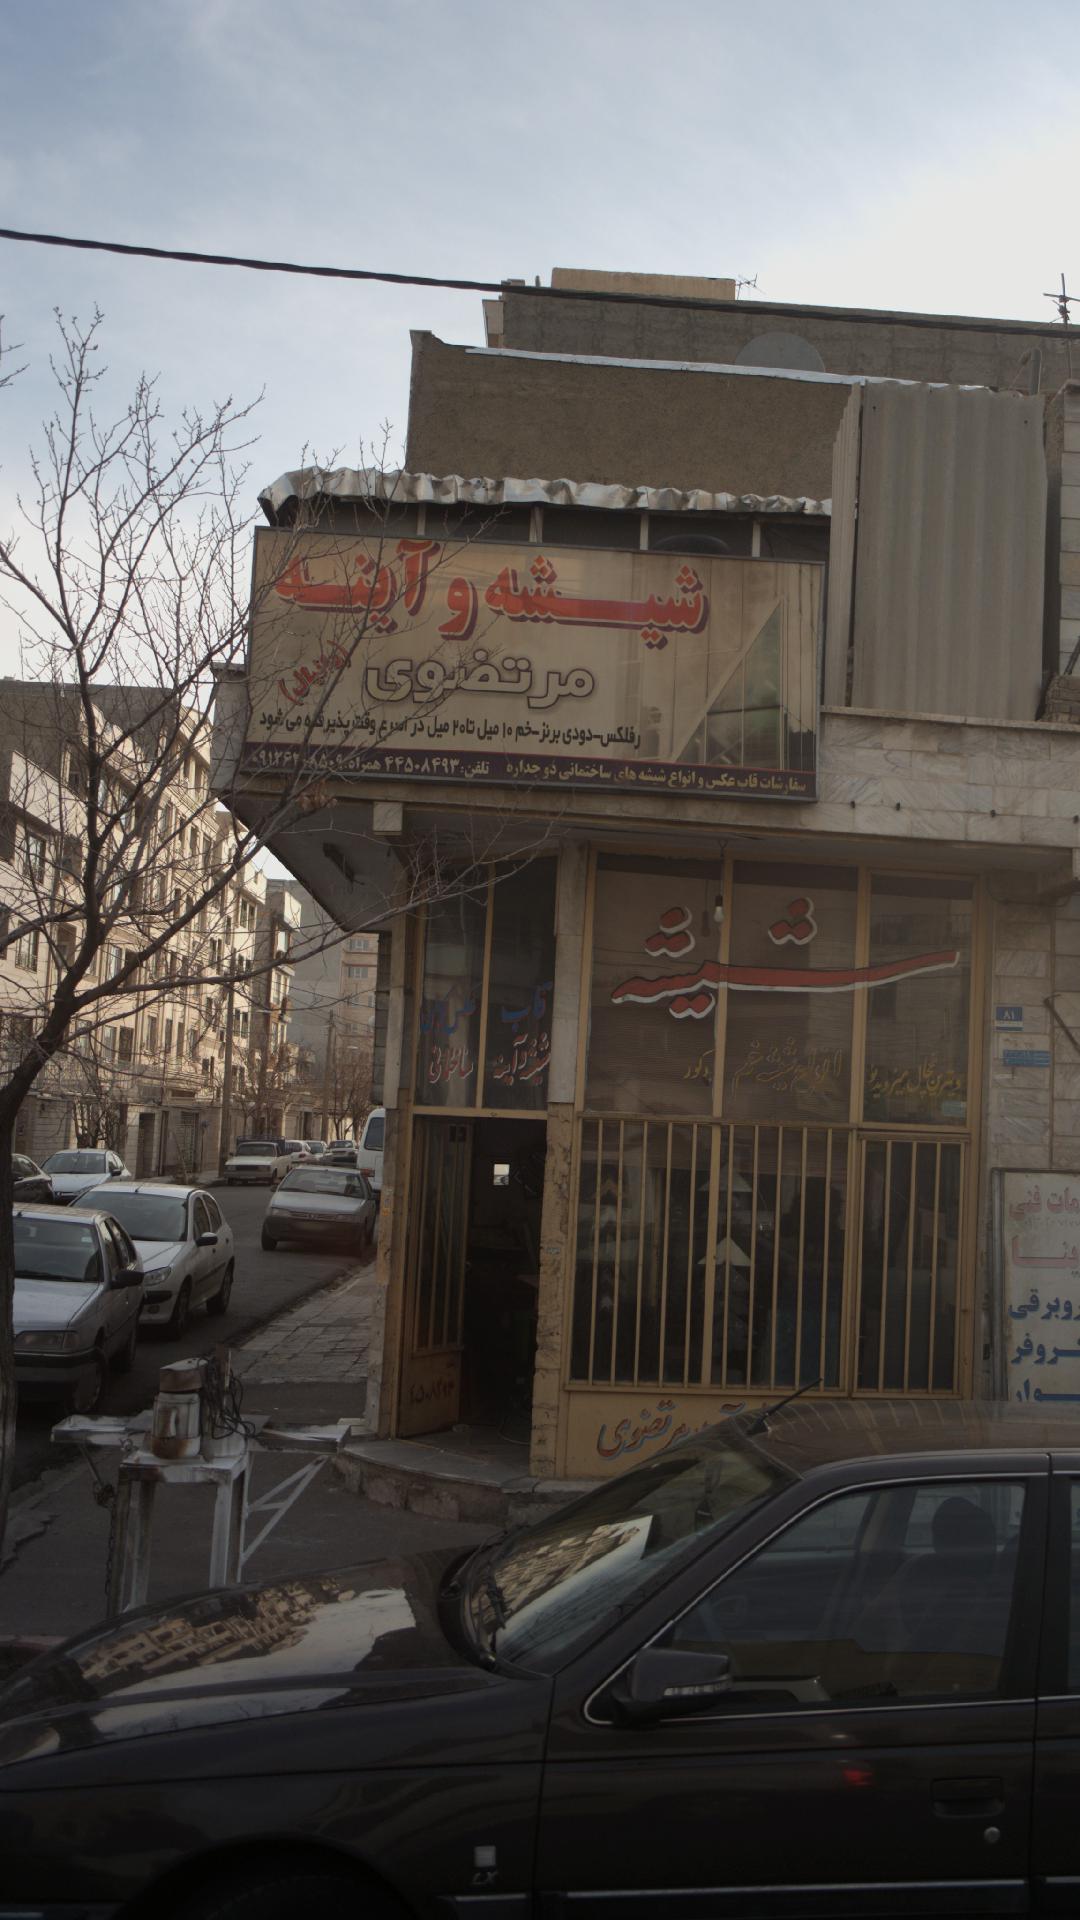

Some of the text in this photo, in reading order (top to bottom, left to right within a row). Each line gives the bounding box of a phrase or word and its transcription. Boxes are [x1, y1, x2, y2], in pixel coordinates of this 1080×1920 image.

[439, 576, 478, 640] و
[485, 554, 709, 650] شیشه
[366, 648, 595, 708] مرتضوی
[410, 719, 425, 738] در
[428, 715, 449, 738] میل
[477, 718, 499, 740] میل
[506, 759, 806, 795] سفارشات قاب عکس و انواع شیشه های ساختمانی دو جداره
